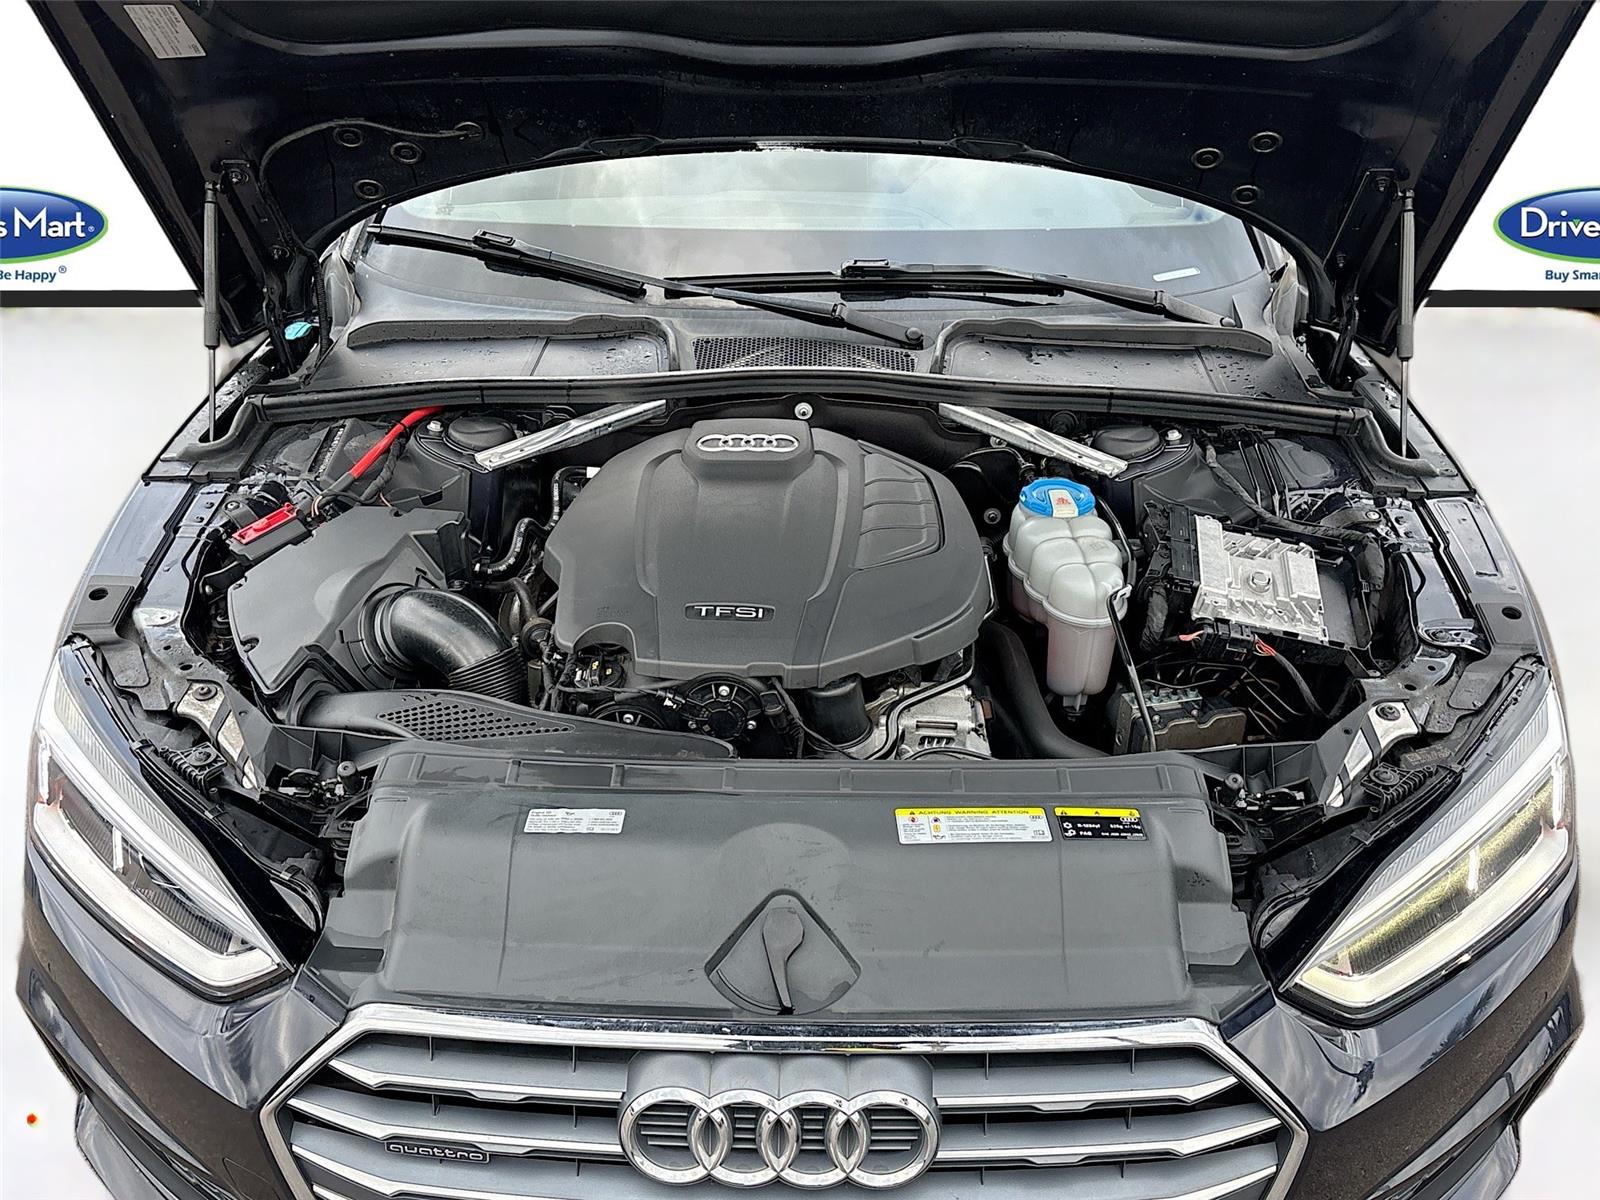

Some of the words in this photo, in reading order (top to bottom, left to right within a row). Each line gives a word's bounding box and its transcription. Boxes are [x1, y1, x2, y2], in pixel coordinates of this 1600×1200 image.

[14, 206, 86, 238] Mart
[1521, 206, 1600, 238] Drive
[15, 269, 57, 283] Happy
[1545, 269, 1570, 283] Buy
[1572, 269, 1600, 281] Sma
[694, 606, 764, 619] TFSI
[389, 1144, 484, 1161] quattro
